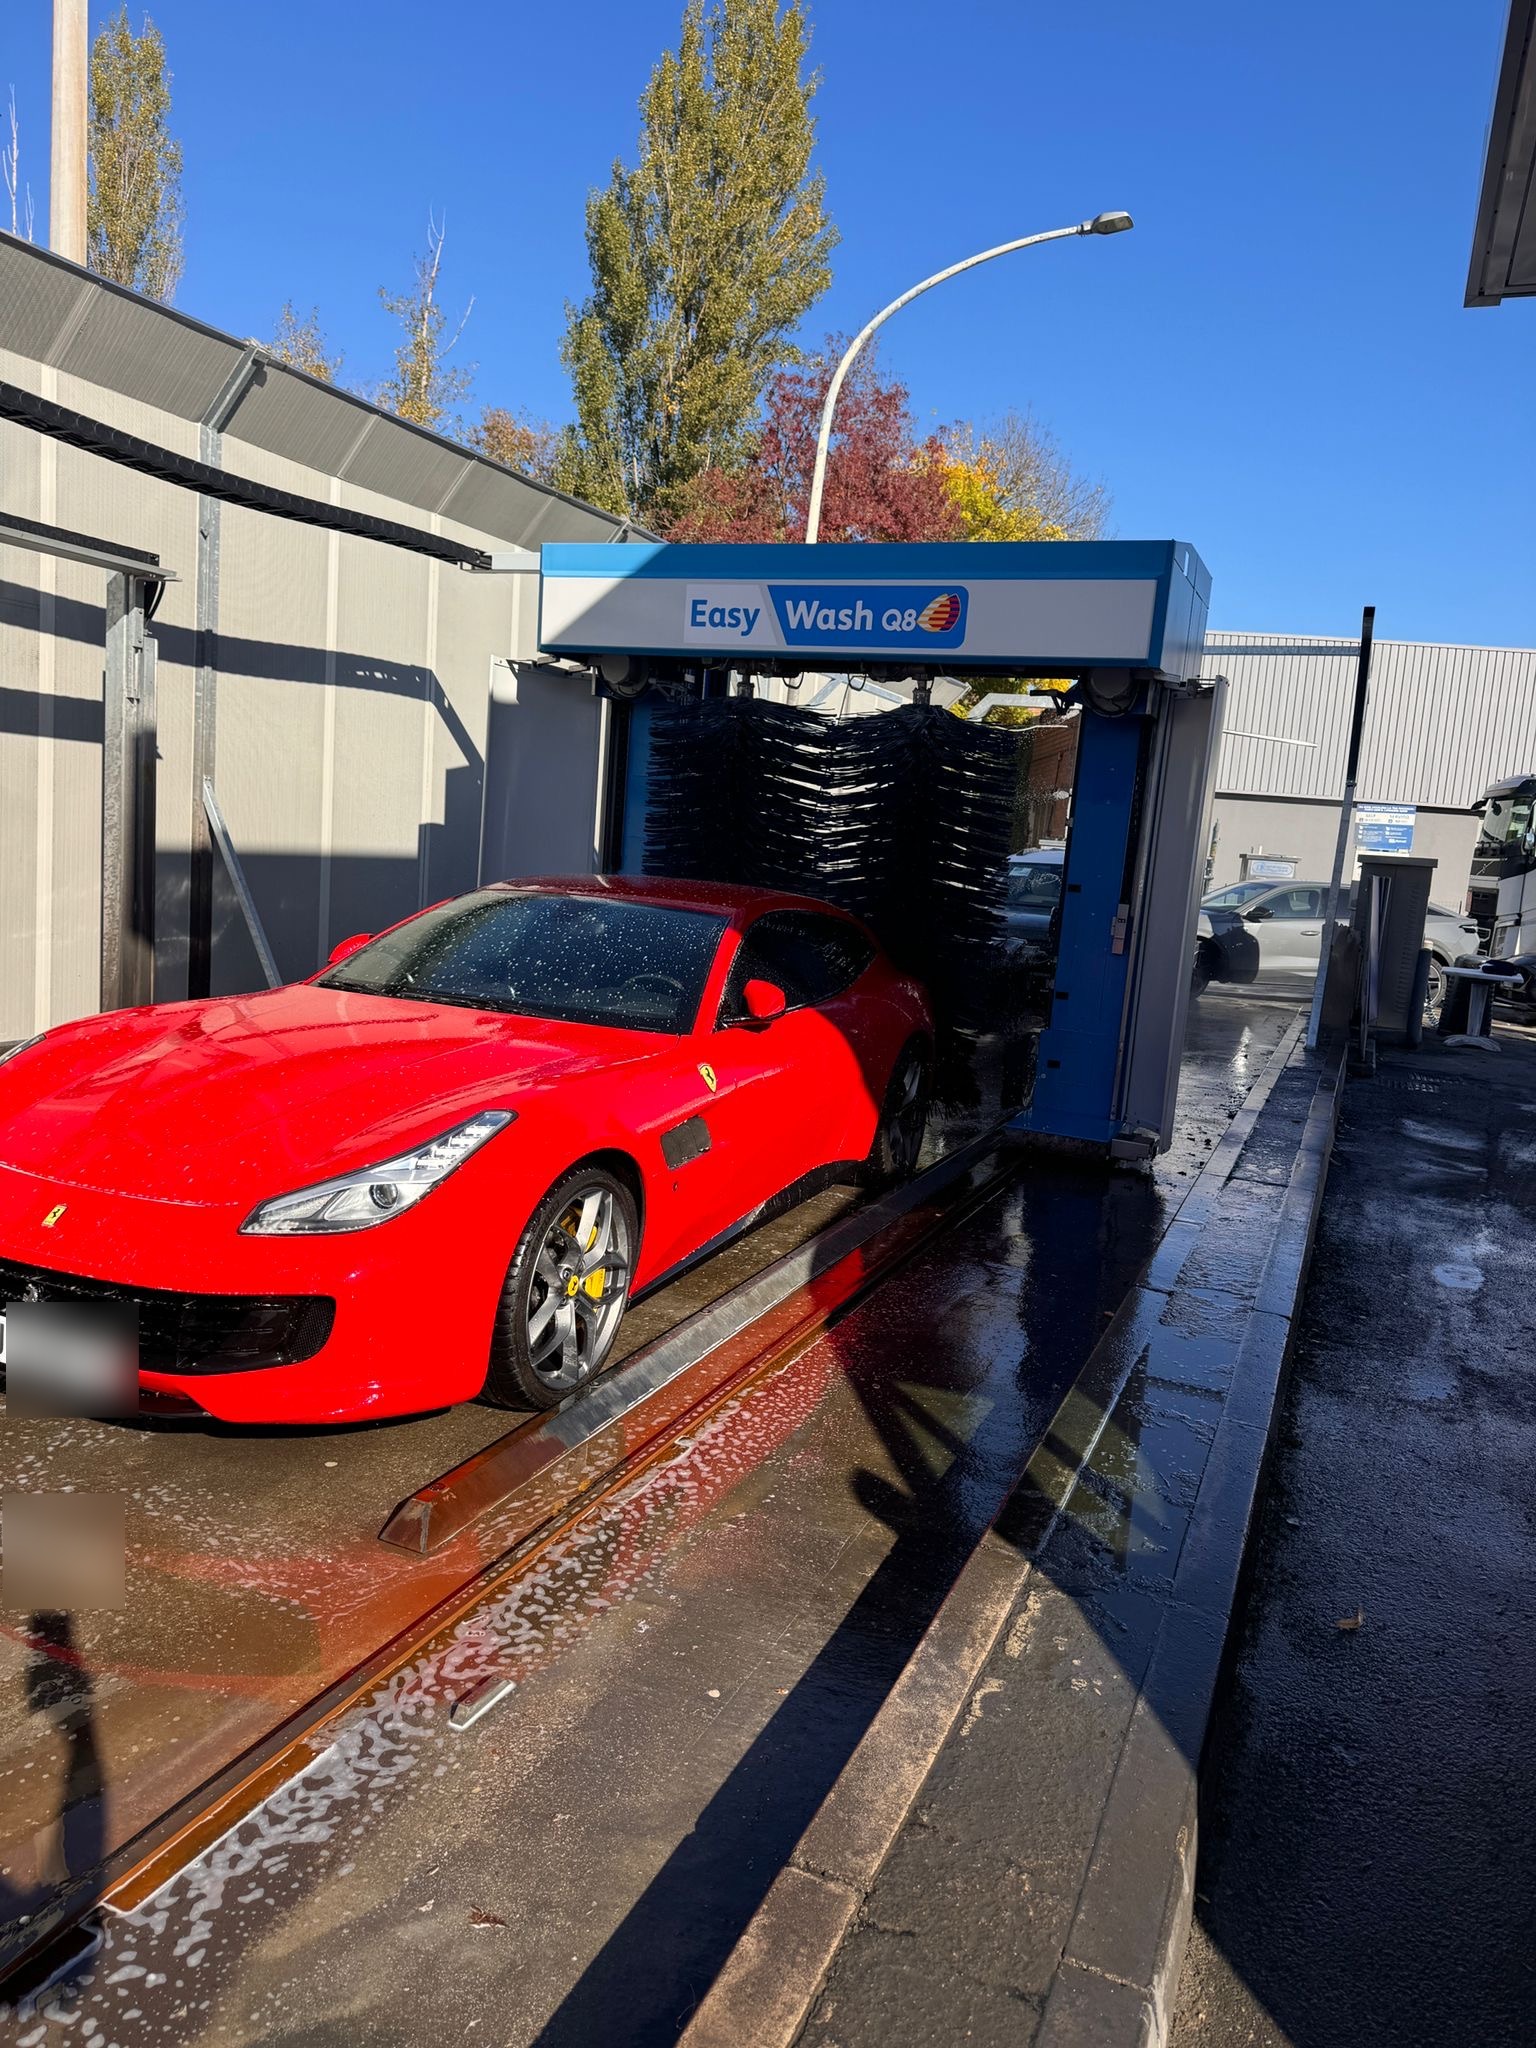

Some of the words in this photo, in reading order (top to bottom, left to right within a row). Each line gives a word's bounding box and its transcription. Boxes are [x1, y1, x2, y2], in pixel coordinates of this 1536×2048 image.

[690, 599, 760, 636] Easy
[785, 600, 873, 631] Wash
[881, 609, 916, 632] Q8
